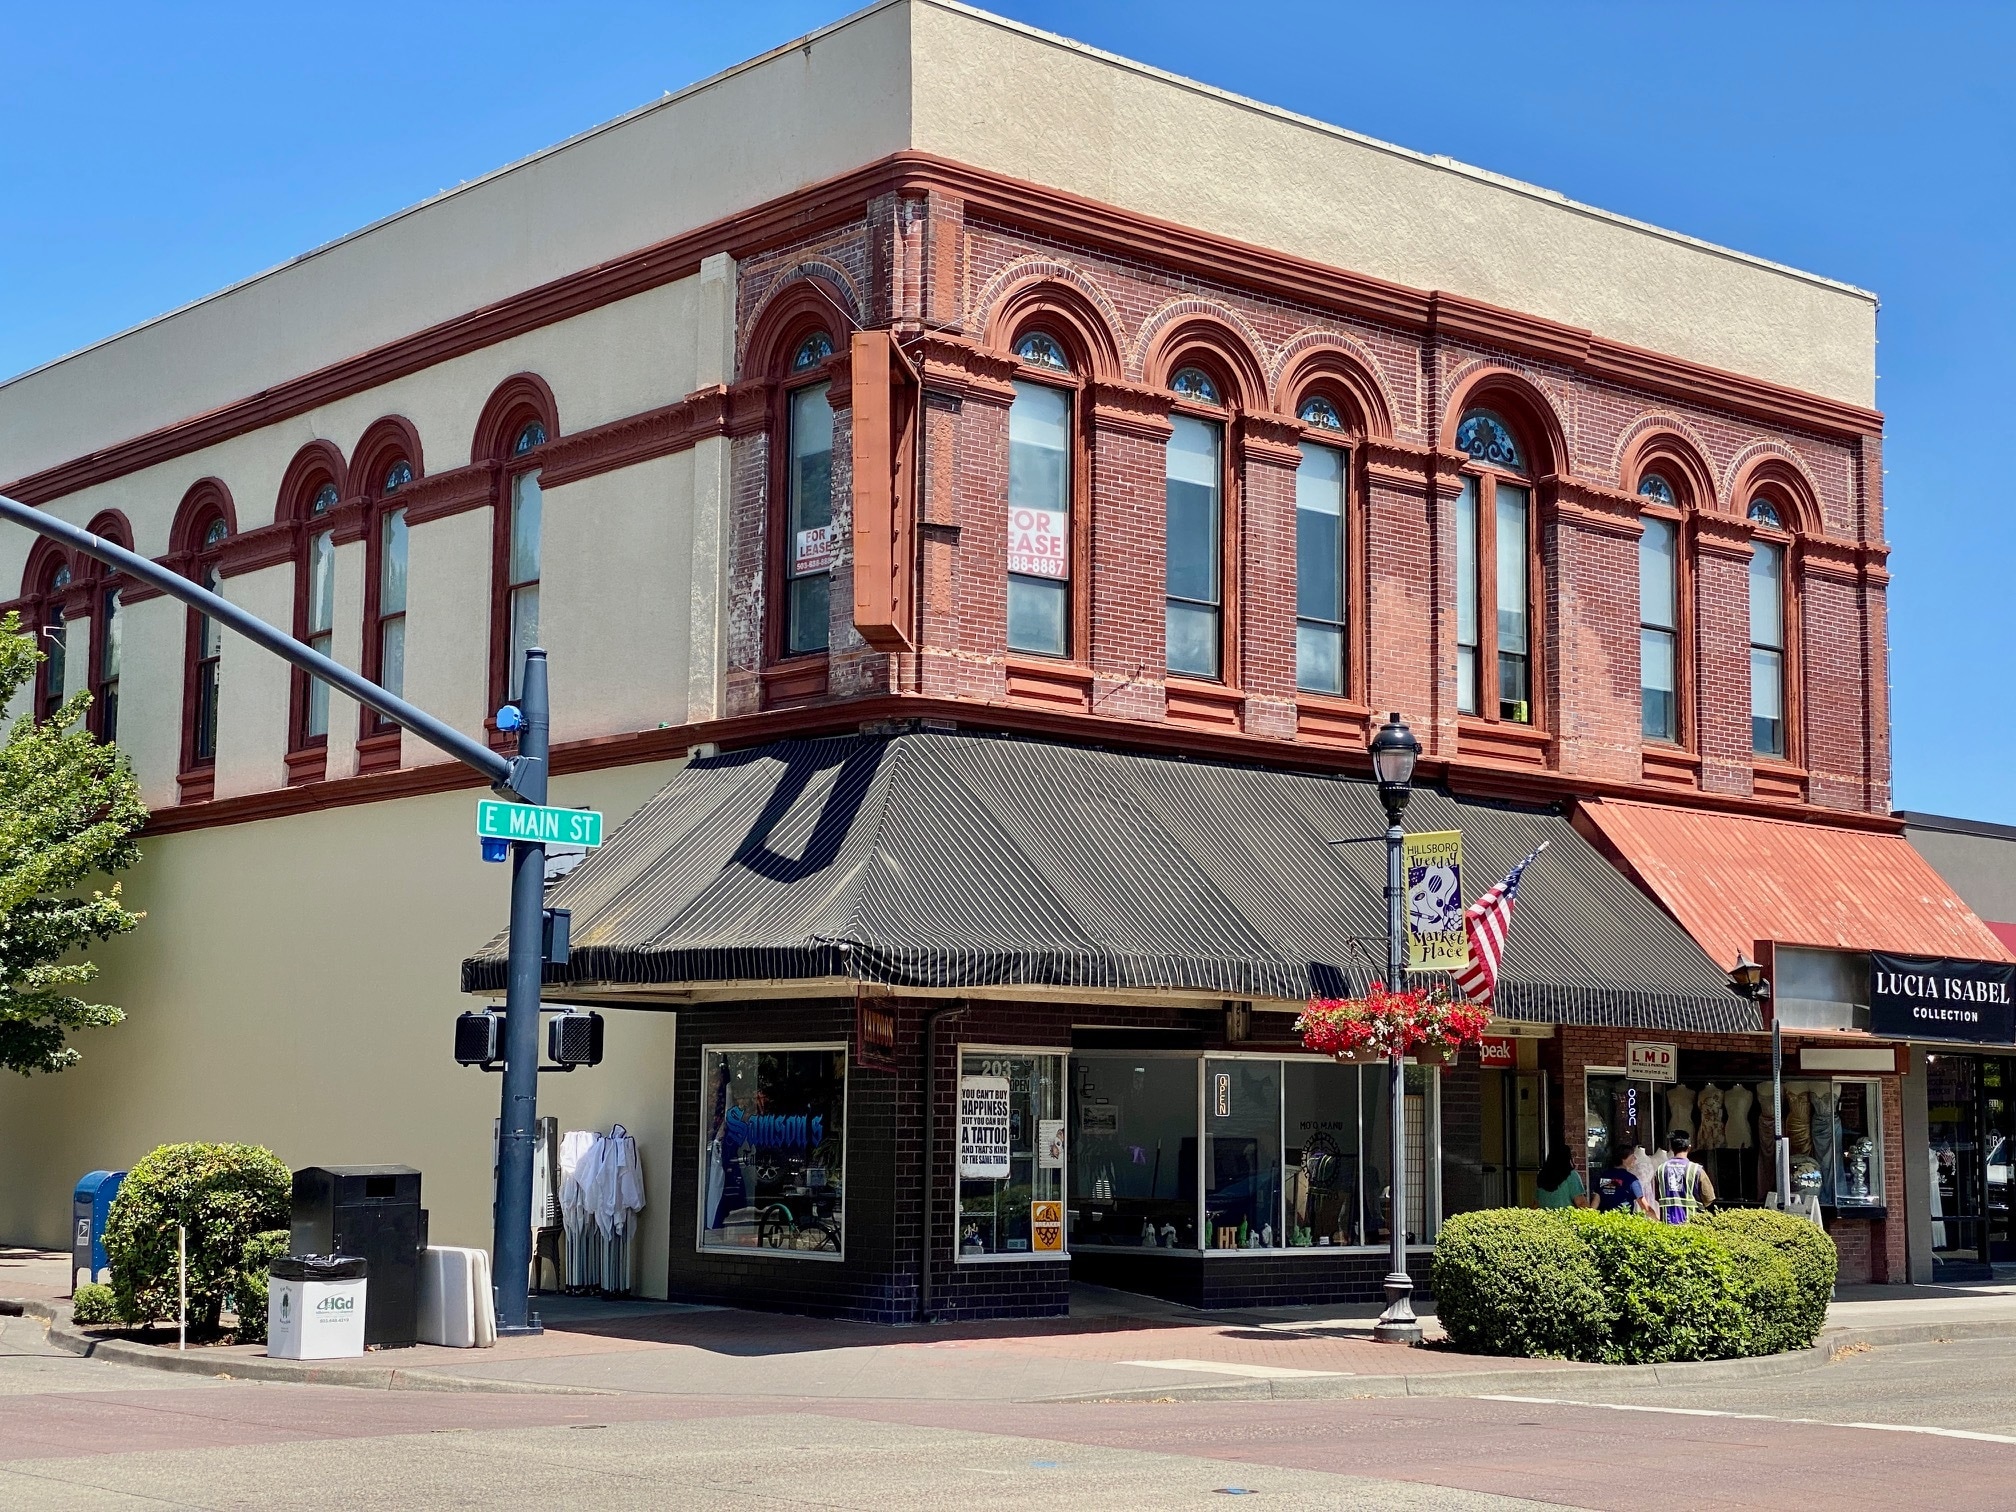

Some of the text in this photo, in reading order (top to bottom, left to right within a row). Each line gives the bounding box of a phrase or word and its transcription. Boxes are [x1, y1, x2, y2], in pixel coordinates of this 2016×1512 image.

[806, 529, 825, 543] FOR
[1008, 531, 1061, 556] EASE
[800, 541, 831, 557] LEASE
[485, 806, 593, 841] E MAIN ST
[1407, 842, 1459, 855] HILLSBORO
[1407, 853, 1457, 869] Tuesday
[1413, 929, 1464, 947] Market
[1876, 972, 2010, 1004] LUCIA ISABEL
[1913, 1007, 1978, 1022] COLLECTION
[982, 1060, 1011, 1076] 203
[1009, 1079, 1030, 1092] OPEN
[962, 1089, 1008, 1100] YOU CAN'T BUY
[1219, 1076, 1228, 1114] OPEN
[962, 1100, 1008, 1116] HAPPINESS
[726, 1104, 823, 1148] Samson's
[962, 1117, 1008, 1126] BUT YOU CAN BUY
[1321, 1121, 1343, 1130] MANU
[962, 1127, 1008, 1144] A TATTOO
[962, 1145, 1008, 1154] AND THAT'S KIND
[962, 1155, 1008, 1165] OF THE SAME THING
[1218, 1226, 1238, 1249] HI
[324, 1297, 354, 1310] HGd
